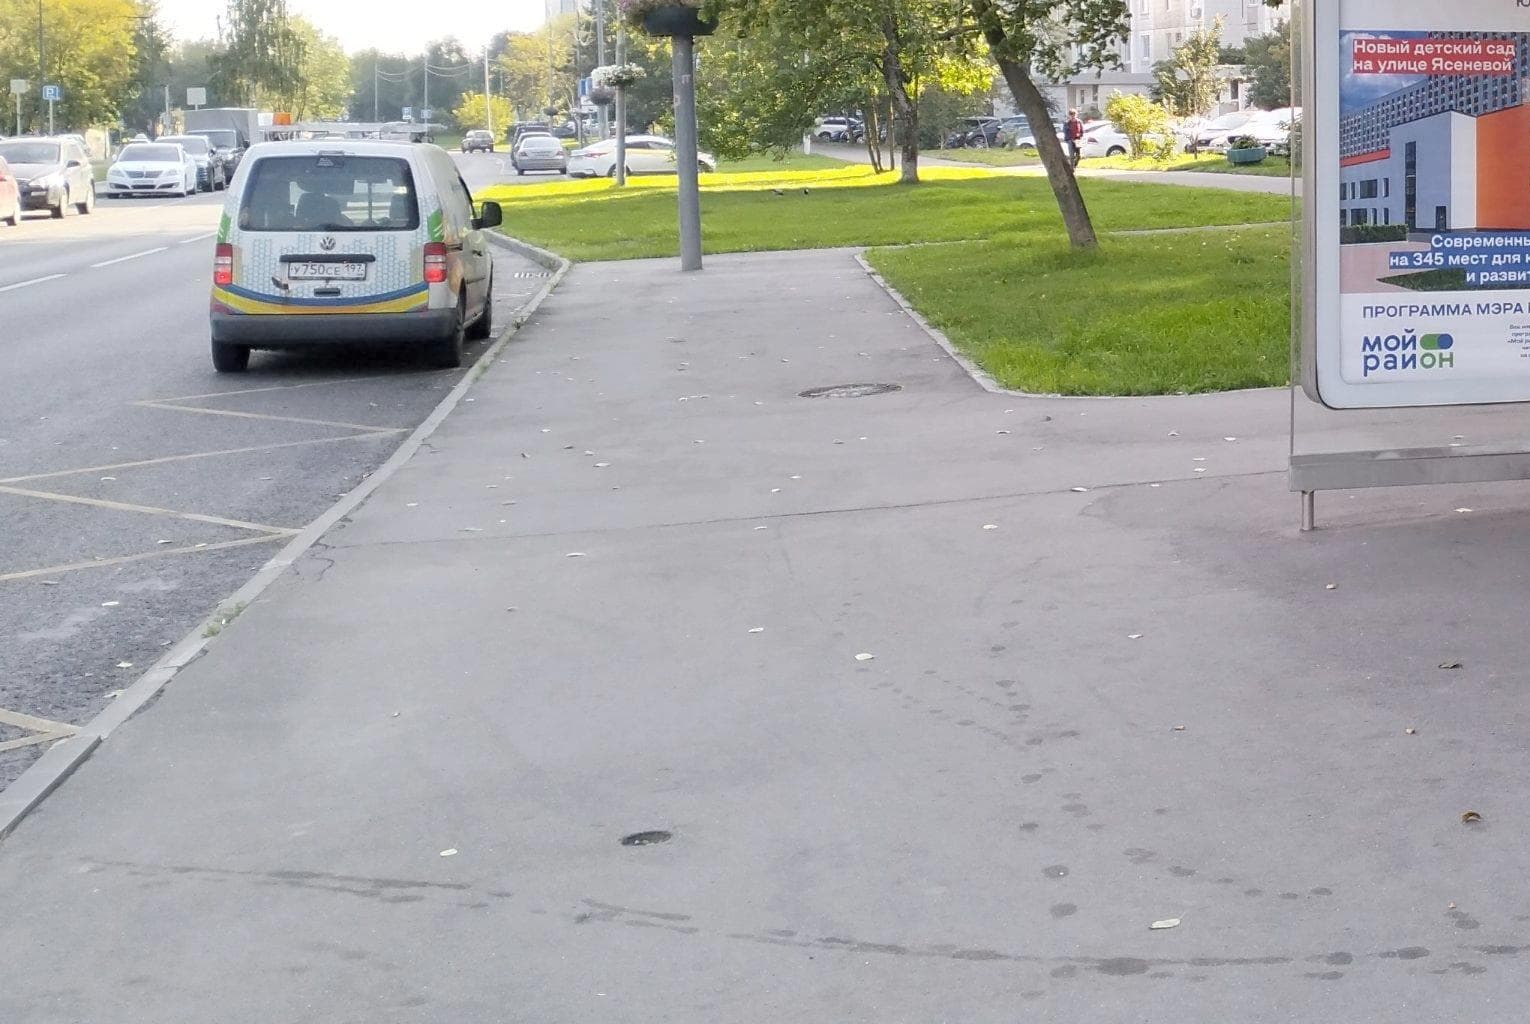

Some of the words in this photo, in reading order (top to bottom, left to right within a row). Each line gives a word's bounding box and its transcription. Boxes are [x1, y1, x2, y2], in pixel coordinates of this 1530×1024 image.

[1353, 39, 1410, 55] Новый
[1414, 41, 1482, 56] детский
[1486, 44, 1516, 57] сад
[1353, 60, 1374, 71] на
[1378, 59, 1428, 73] улице
[1431, 57, 1512, 72] Ясеневой
[1390, 256, 1409, 266] на
[1412, 252, 1444, 266] 345
[1448, 254, 1488, 265] мест
[1492, 253, 1521, 266] для
[1466, 271, 1476, 282] и
[1362, 303, 1472, 319] ПРОГРАММА
[1476, 302, 1524, 315] МЭРА
[1362, 328, 1417, 352] мой
